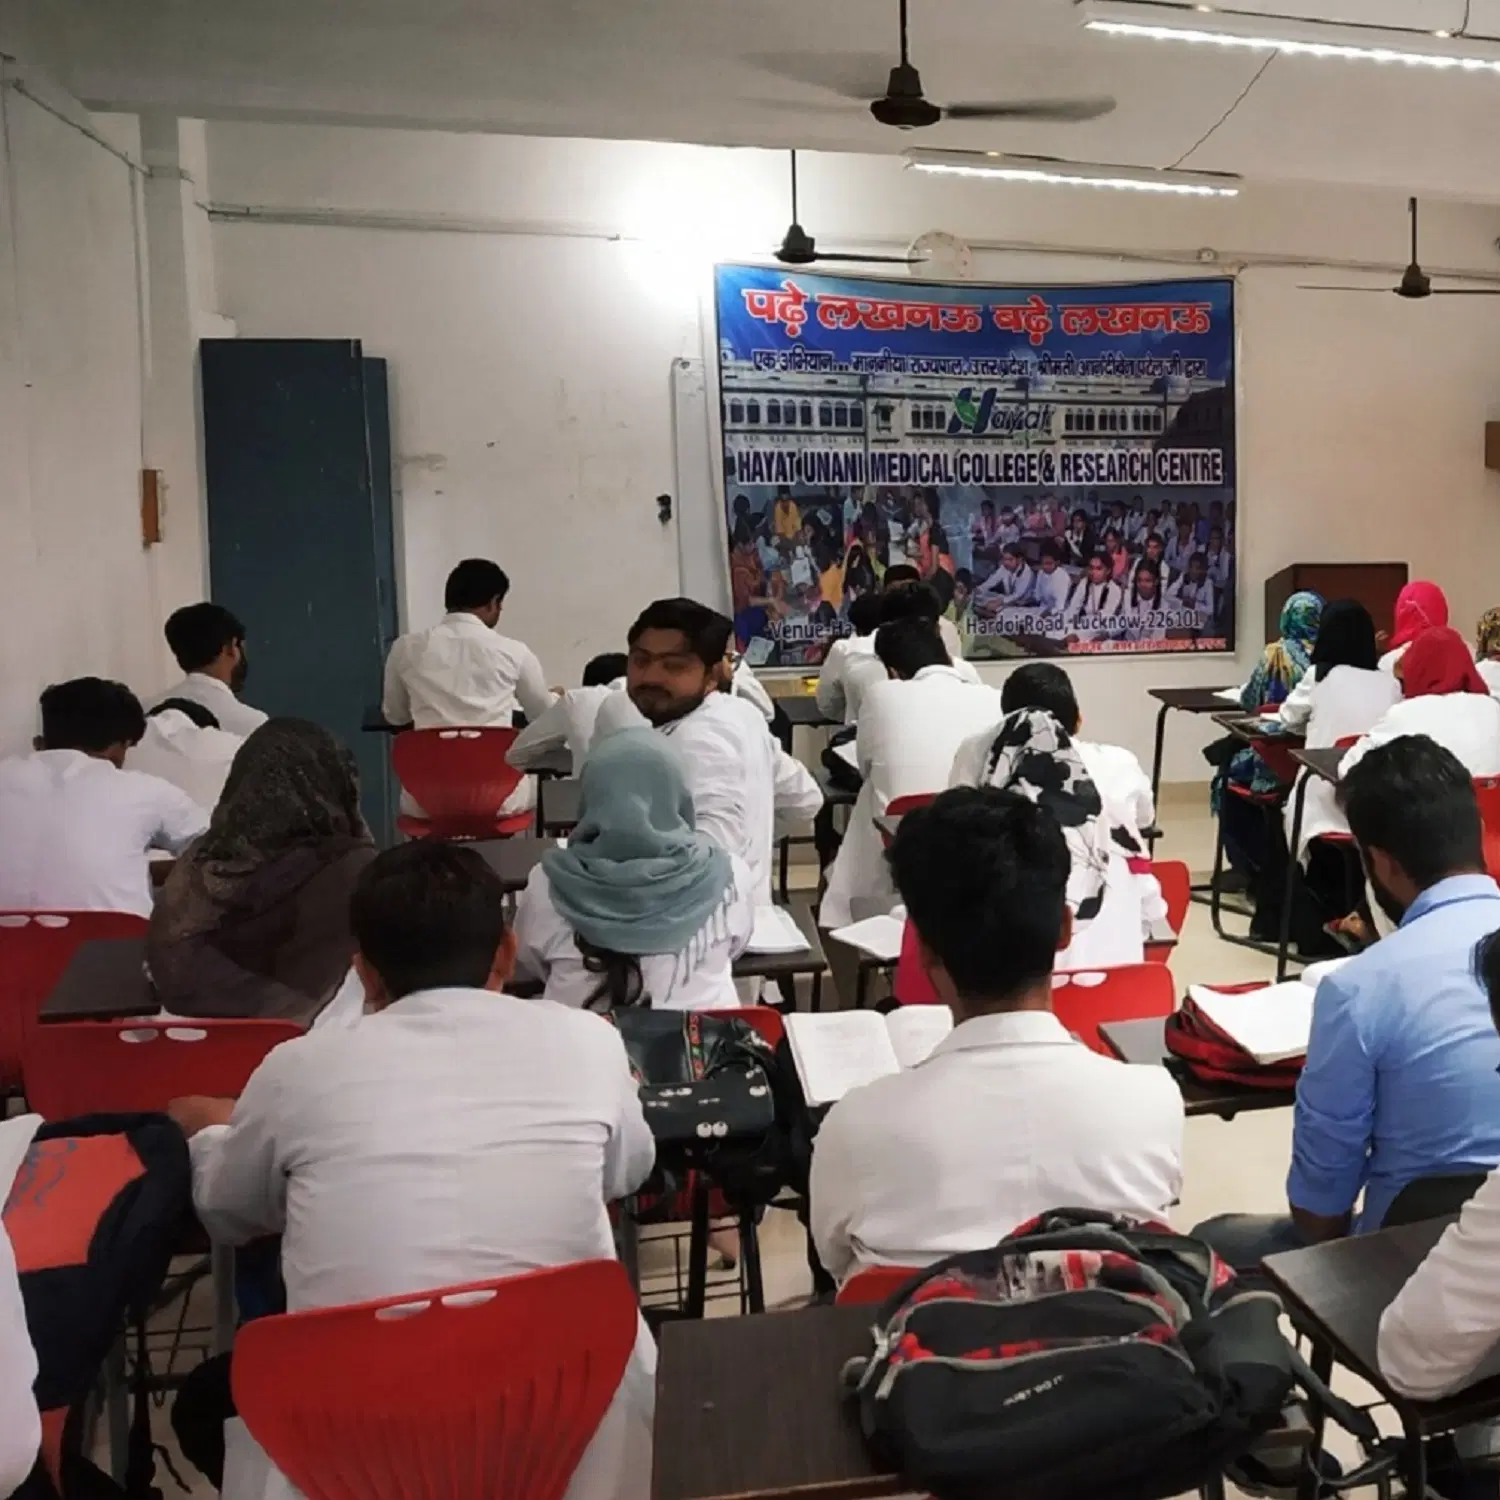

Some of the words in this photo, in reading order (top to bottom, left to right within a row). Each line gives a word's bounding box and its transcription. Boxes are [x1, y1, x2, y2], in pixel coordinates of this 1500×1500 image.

[814, 293, 982, 332] लखनऊ
[1057, 302, 1212, 335] लखनऊ
[752, 349, 777, 372] एक
[738, 451, 796, 484] HAYAT
[803, 451, 864, 484] UNANI
[870, 452, 954, 484] MEDICAL
[959, 452, 1037, 484] COLLEGE
[1041, 453, 1055, 484] &
[1060, 452, 1152, 483] RESEARCH
[1157, 451, 1221, 483] CENTRE
[966, 615, 1019, 634] Hardoi
